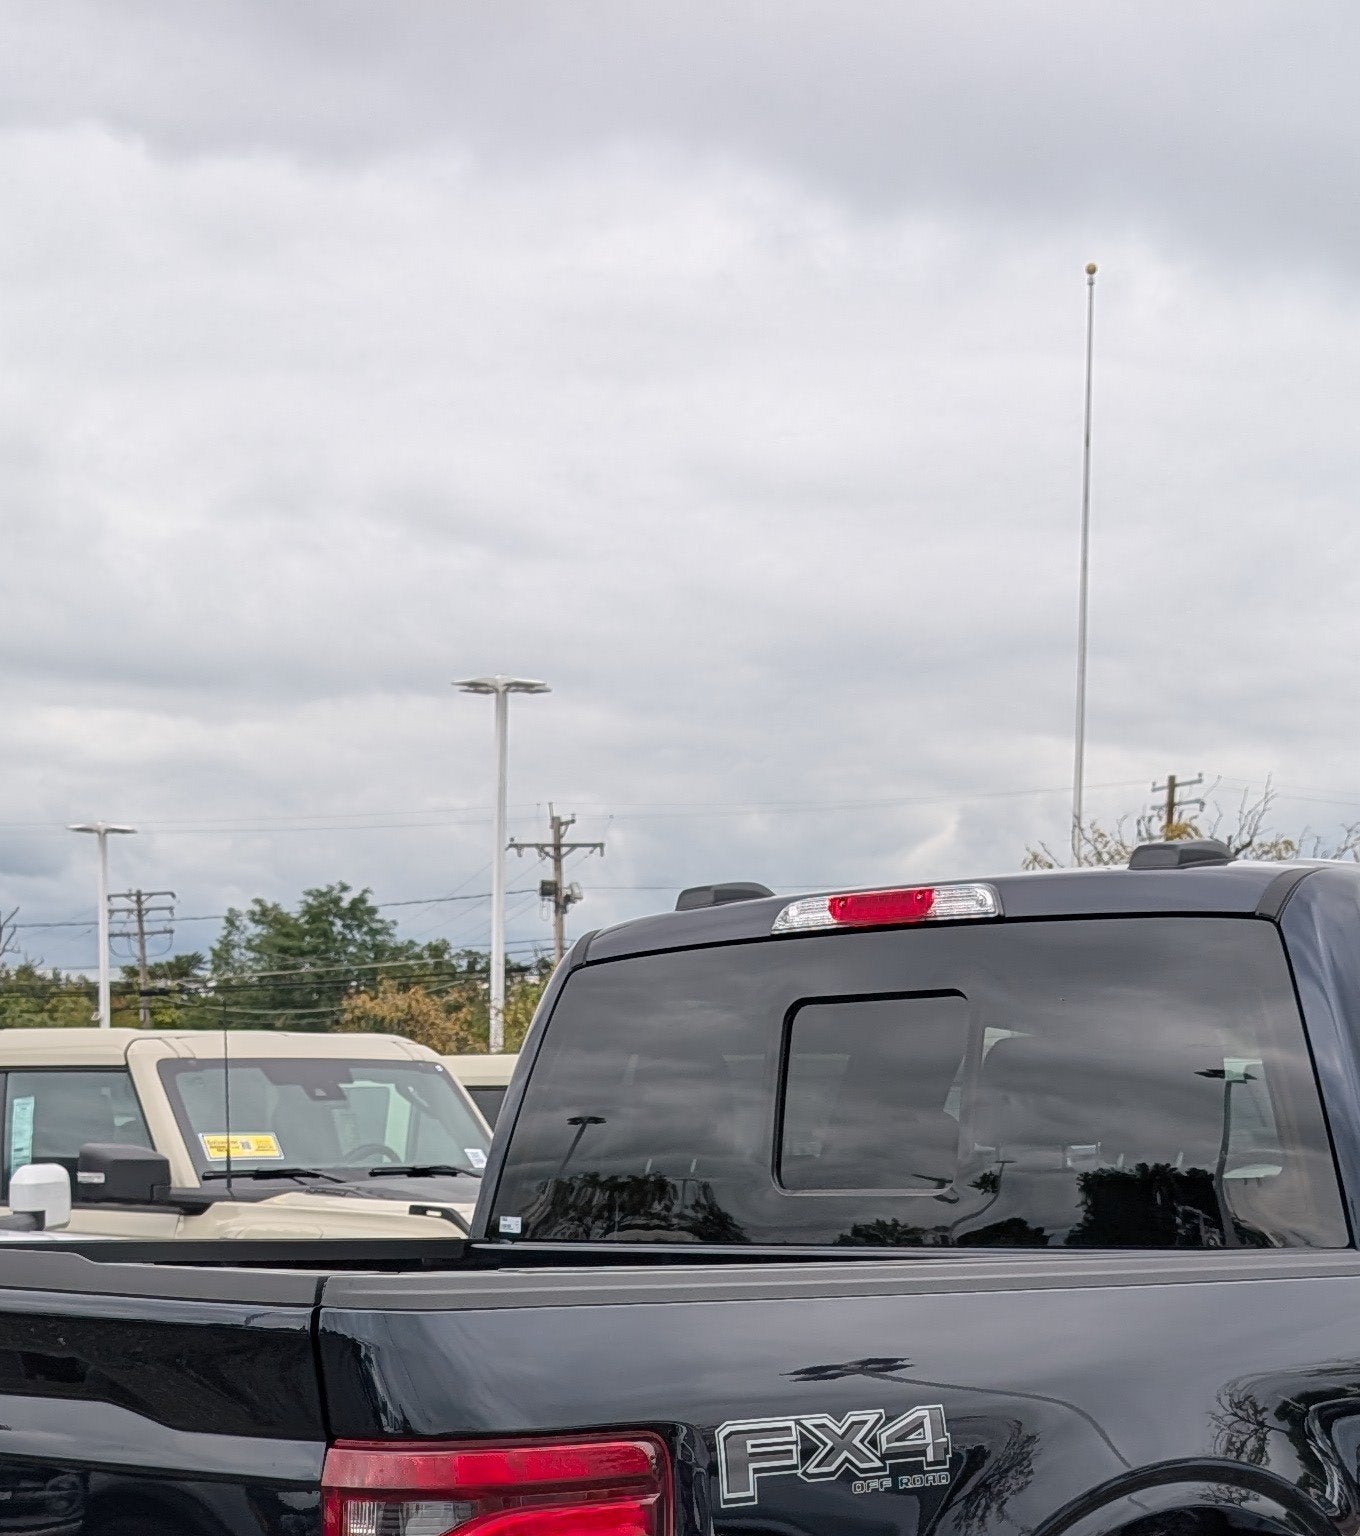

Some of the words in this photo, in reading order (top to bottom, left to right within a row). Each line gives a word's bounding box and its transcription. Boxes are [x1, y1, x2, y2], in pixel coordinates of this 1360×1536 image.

[715, 1403, 952, 1508] FX4
[851, 1477, 892, 1495] OFF
[898, 1472, 951, 1490] ROAD
